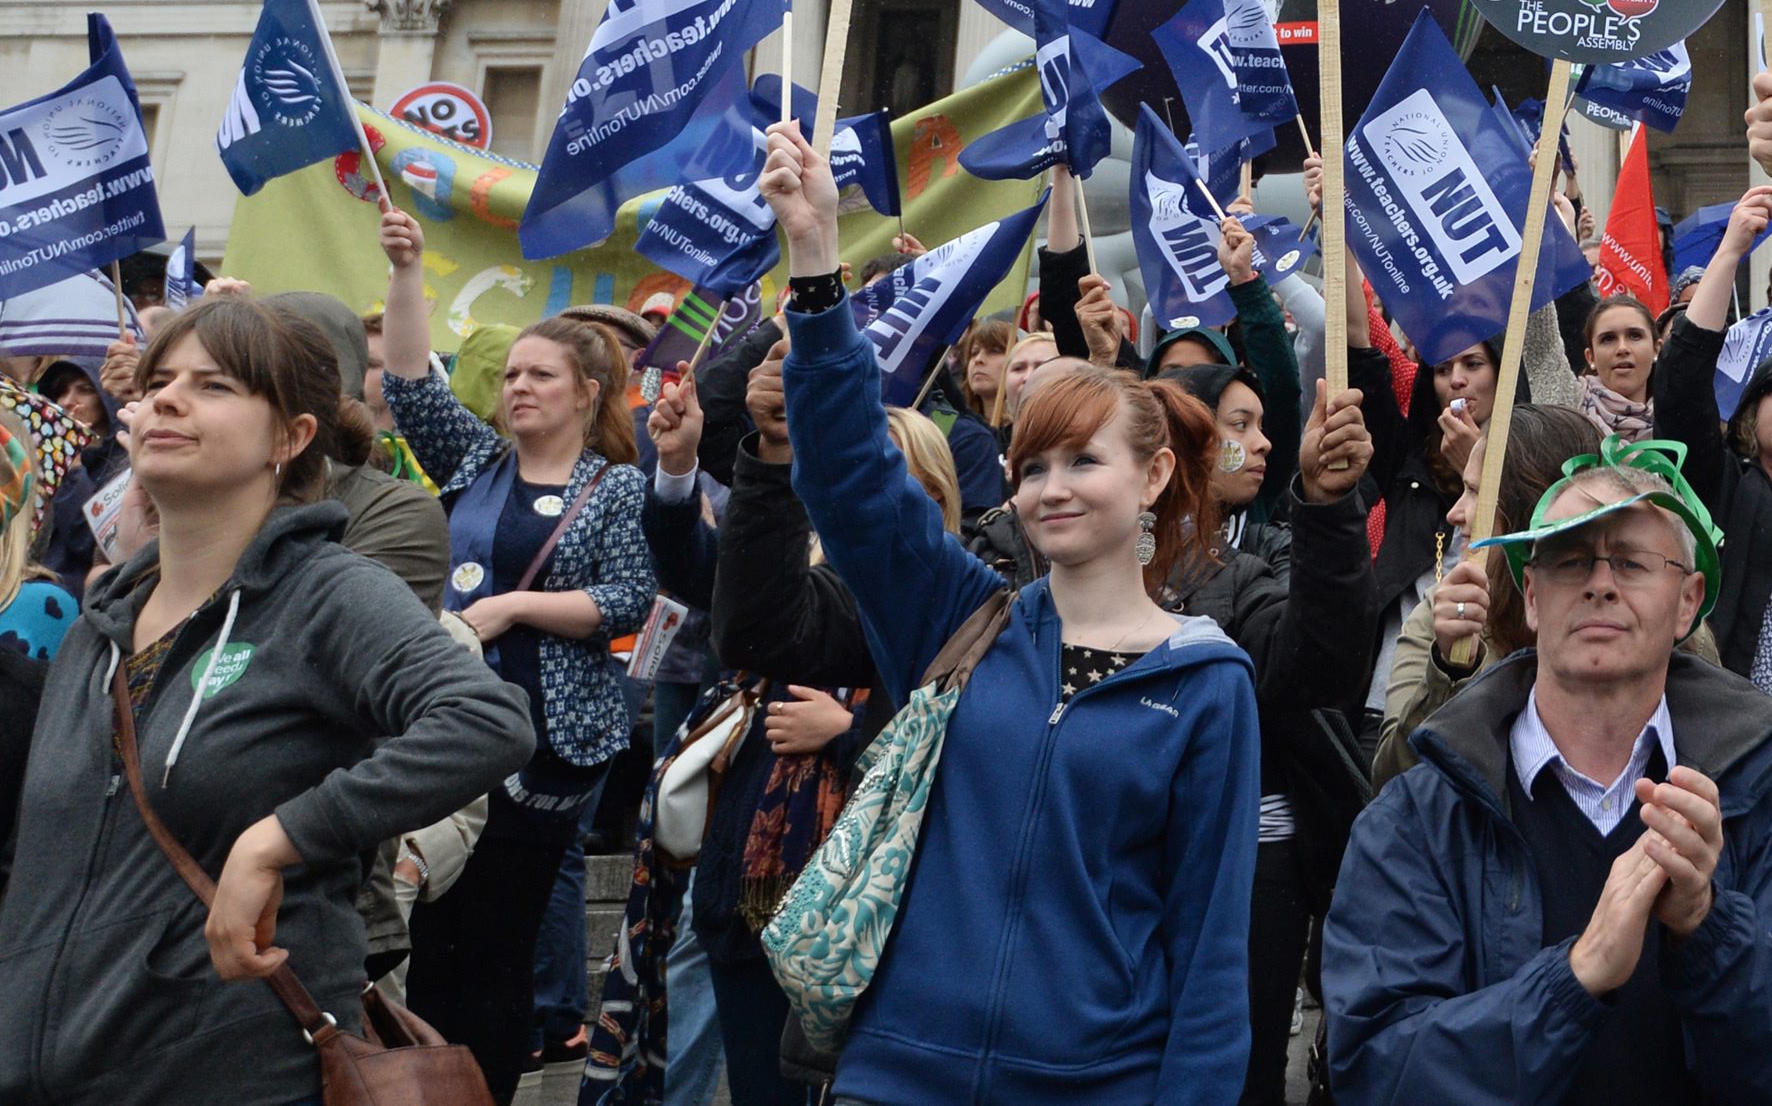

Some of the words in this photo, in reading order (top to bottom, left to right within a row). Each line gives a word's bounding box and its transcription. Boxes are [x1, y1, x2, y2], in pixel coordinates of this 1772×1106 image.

[1519, 0, 1543, 12] THE
[1280, 27, 1292, 38] to
[1294, 26, 1313, 38] win
[1517, 10, 1641, 42] PEOPLE'S
[1576, 37, 1636, 52] ASSEMBLY
[1347, 134, 1454, 301] www.teachers.org.uk
[1420, 167, 1510, 265] NUT
[233, 649, 251, 662] all
